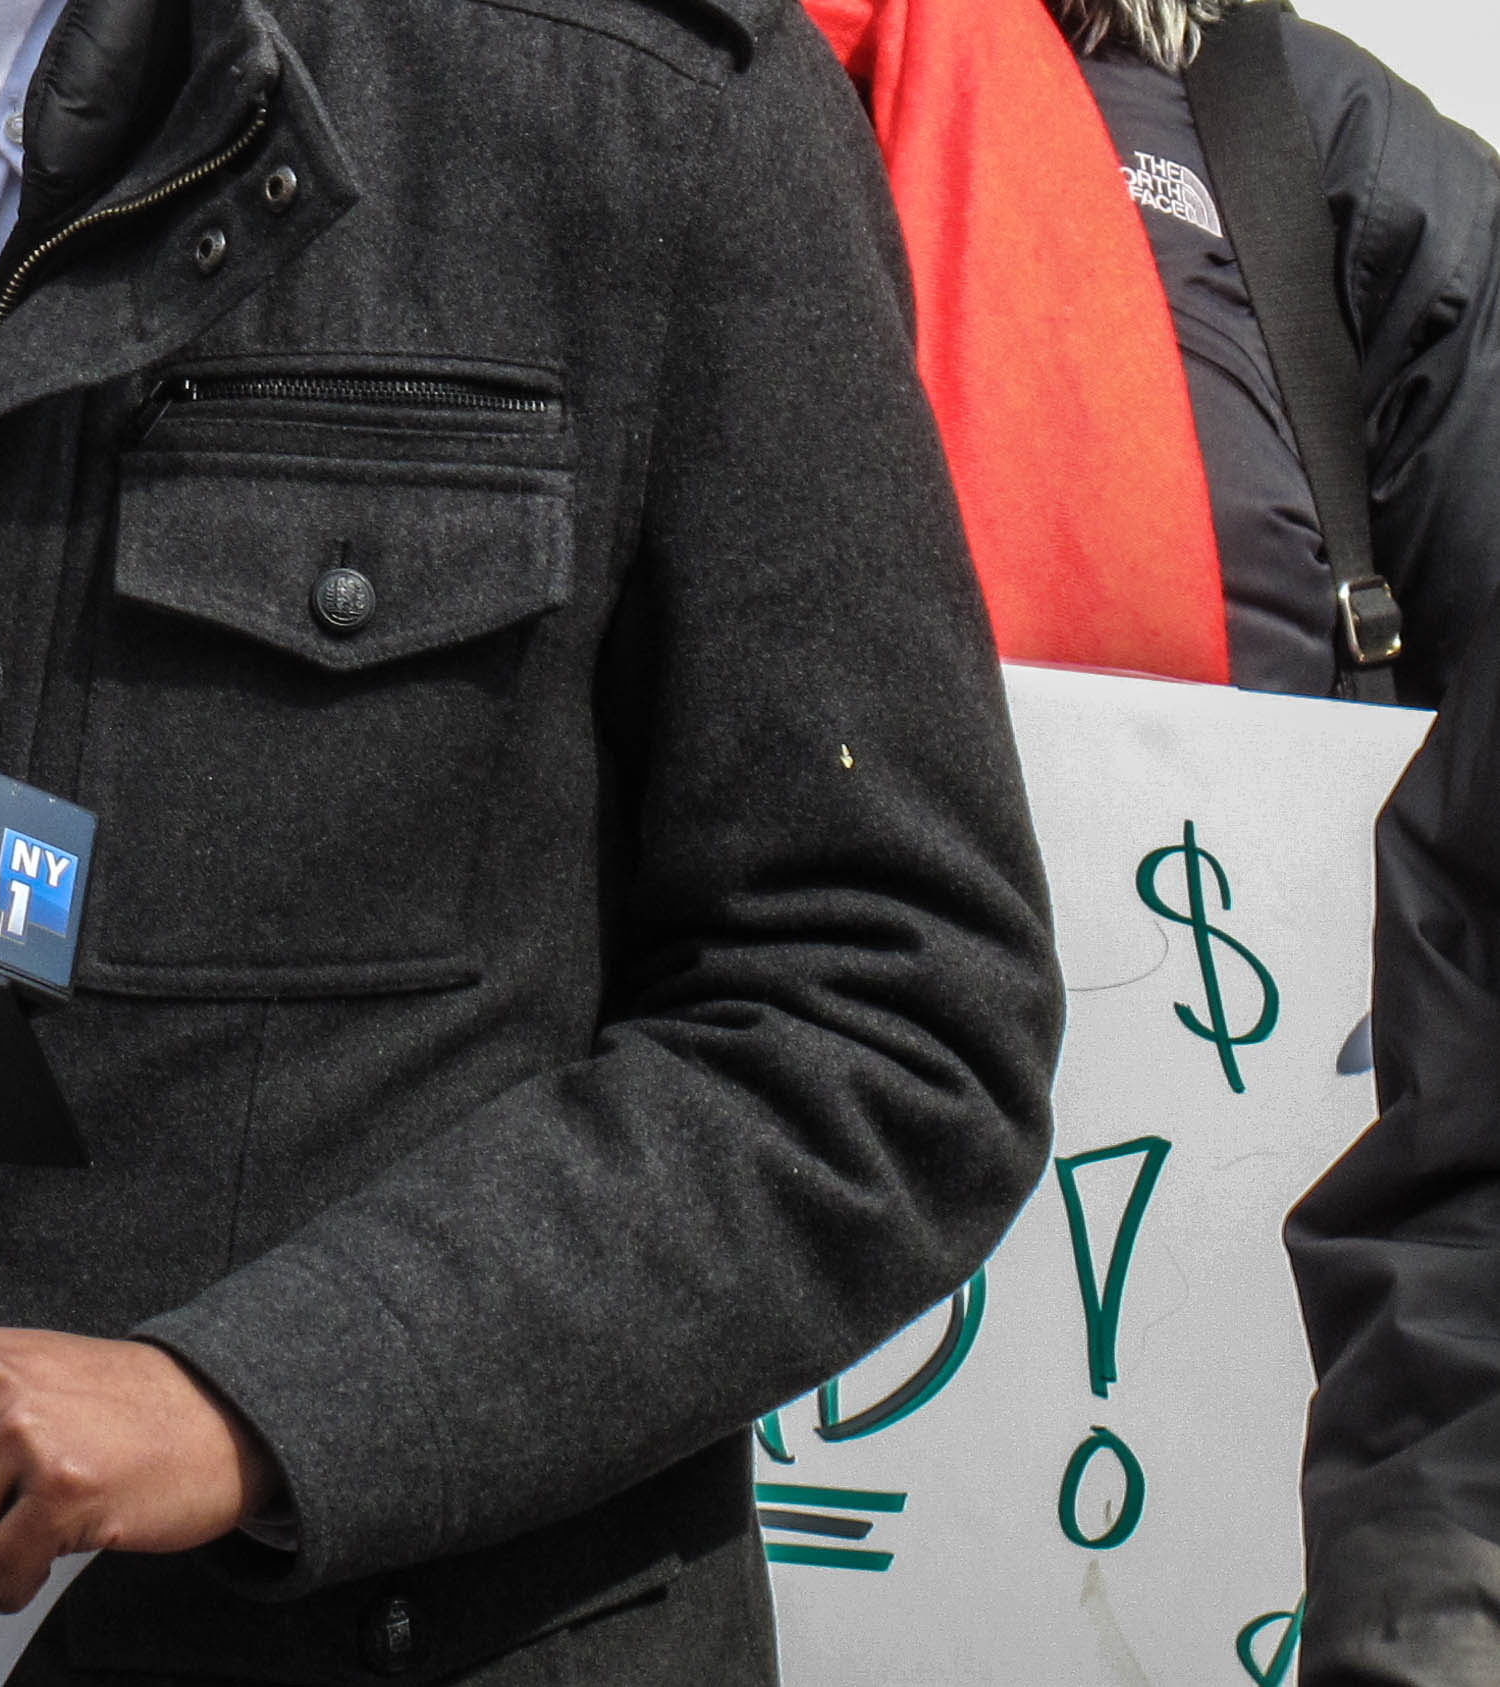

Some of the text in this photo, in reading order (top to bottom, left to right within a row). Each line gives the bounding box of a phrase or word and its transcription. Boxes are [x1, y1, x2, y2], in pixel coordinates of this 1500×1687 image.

[1119, 166, 1183, 203] ORTH
[1133, 150, 1183, 184] THE
[1128, 184, 1187, 221] FACE
[10, 838, 71, 889] NY
[5, 879, 30, 937] 1
